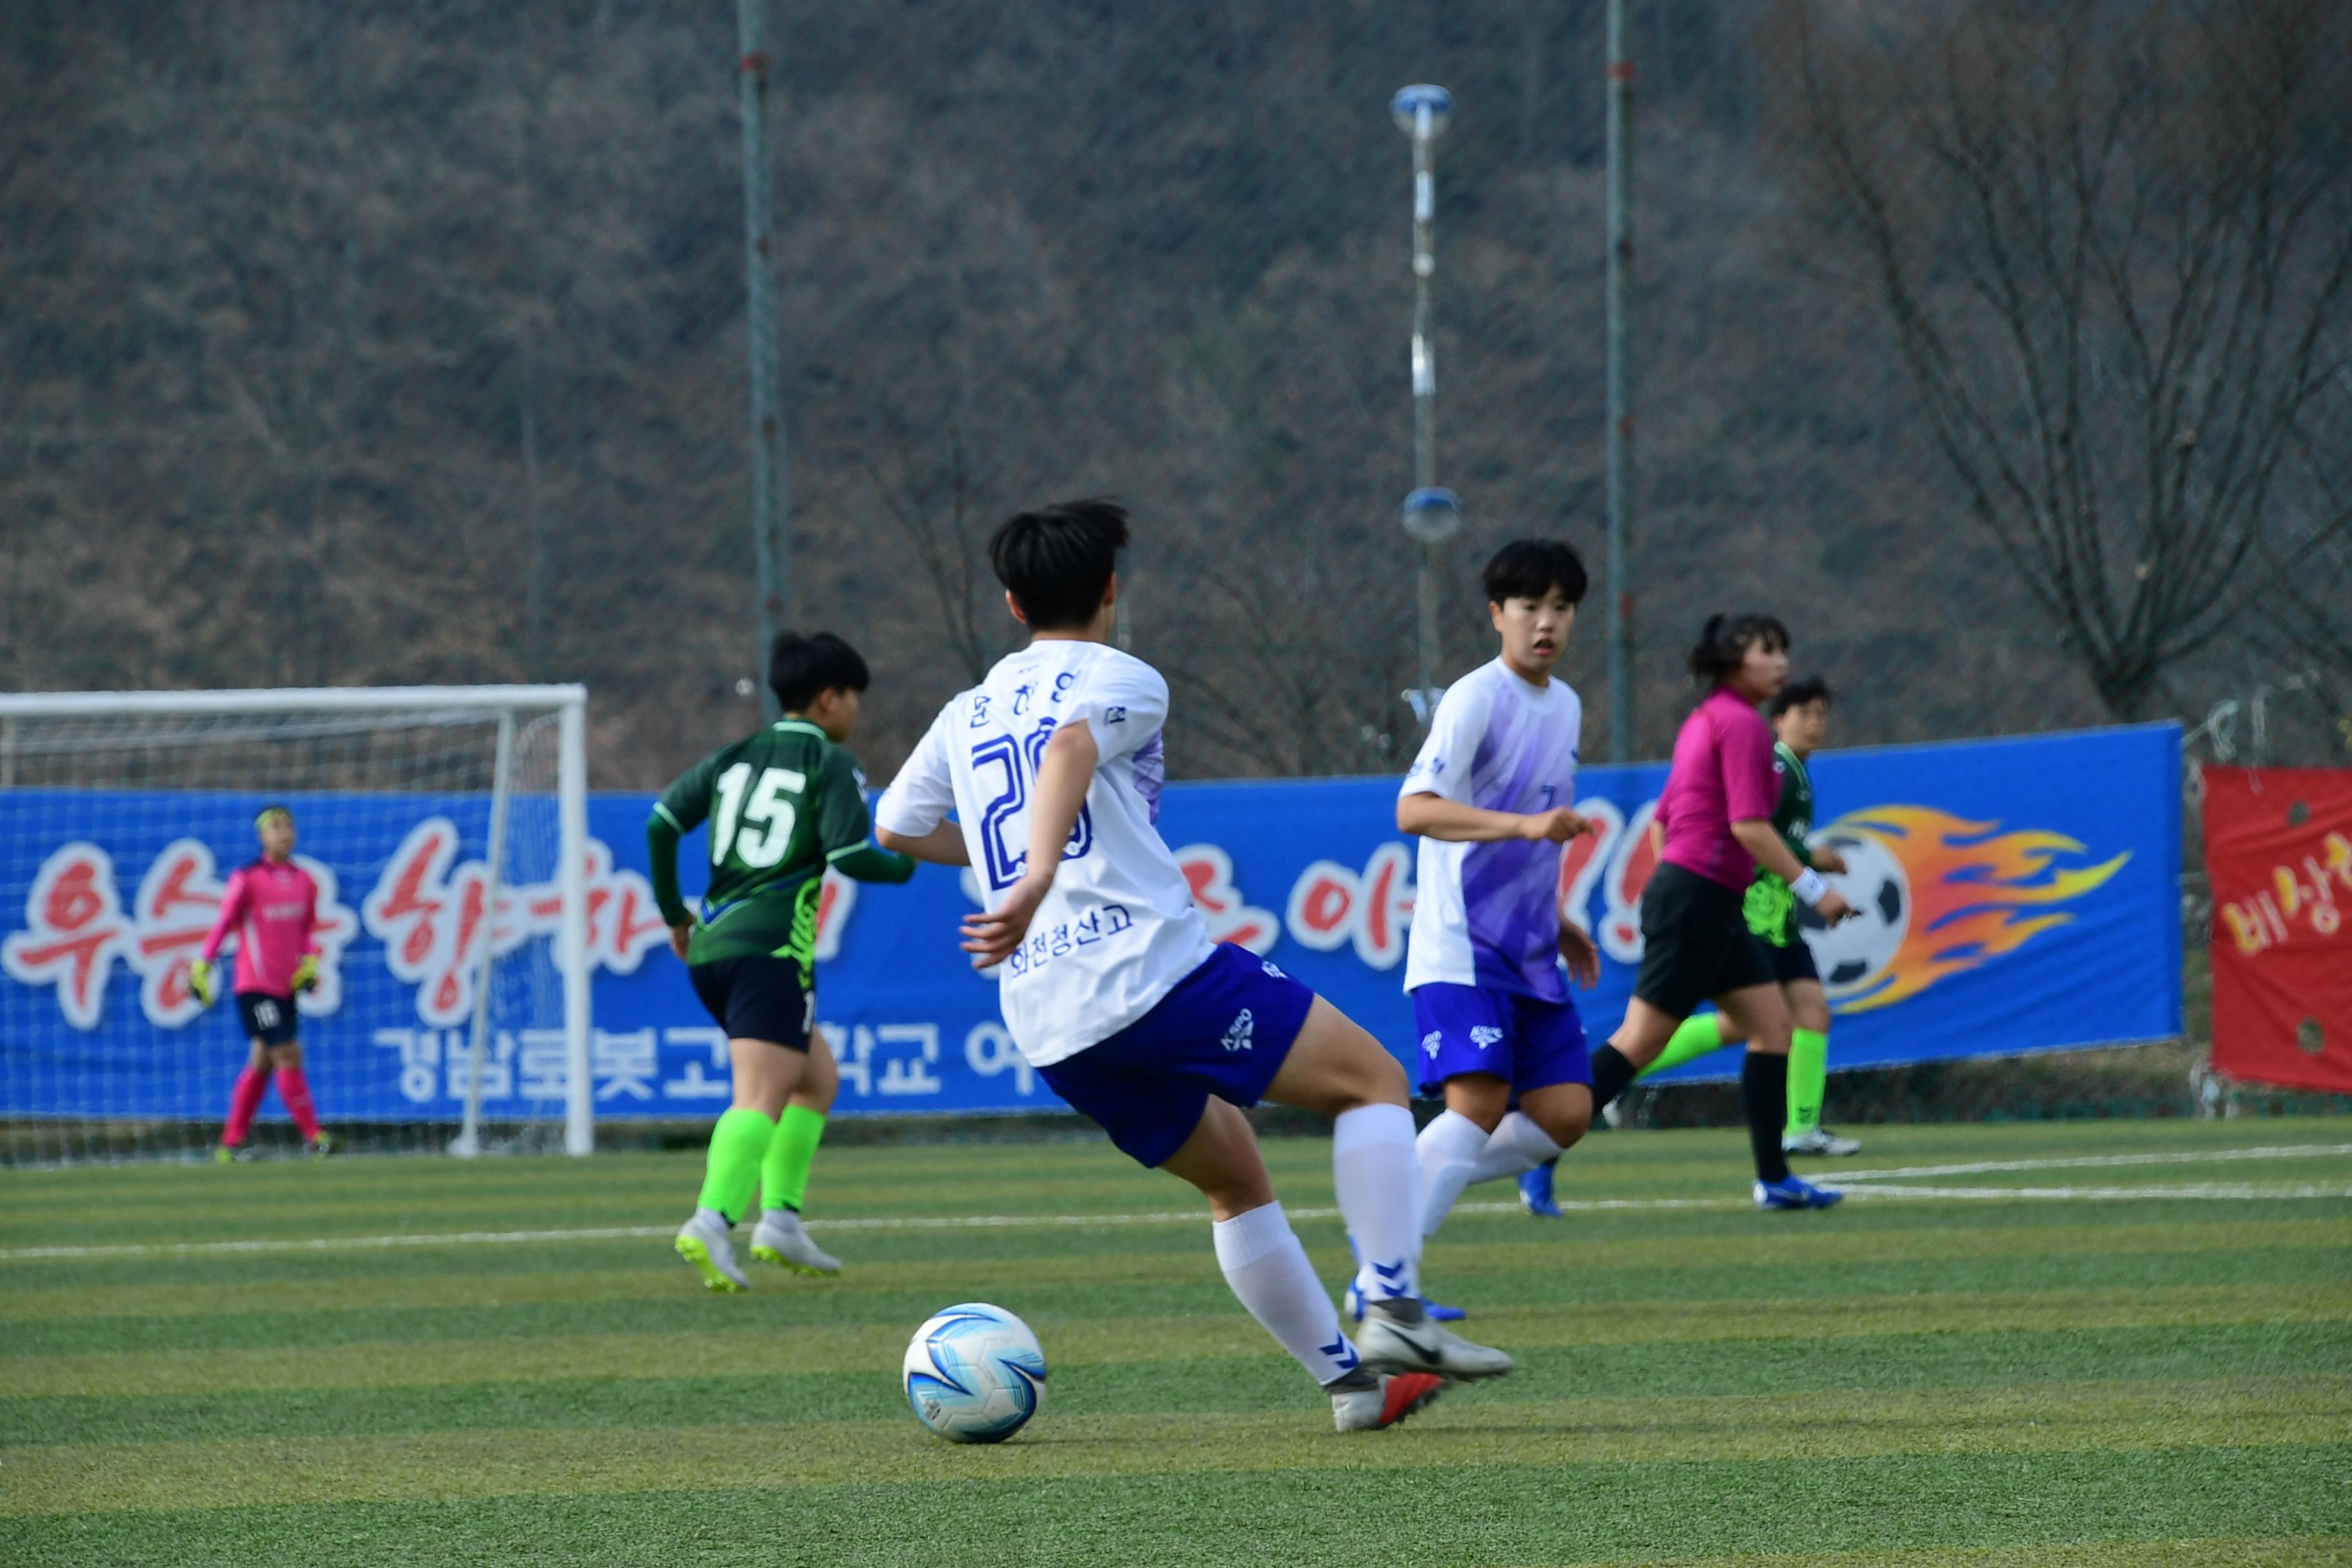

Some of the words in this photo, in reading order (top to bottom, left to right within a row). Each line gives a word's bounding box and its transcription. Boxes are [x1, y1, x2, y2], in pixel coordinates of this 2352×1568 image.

[712, 762, 807, 868] 15
[3, 838, 358, 1032] 우승
[372, 1020, 941, 1102] 경남로봇고학교
